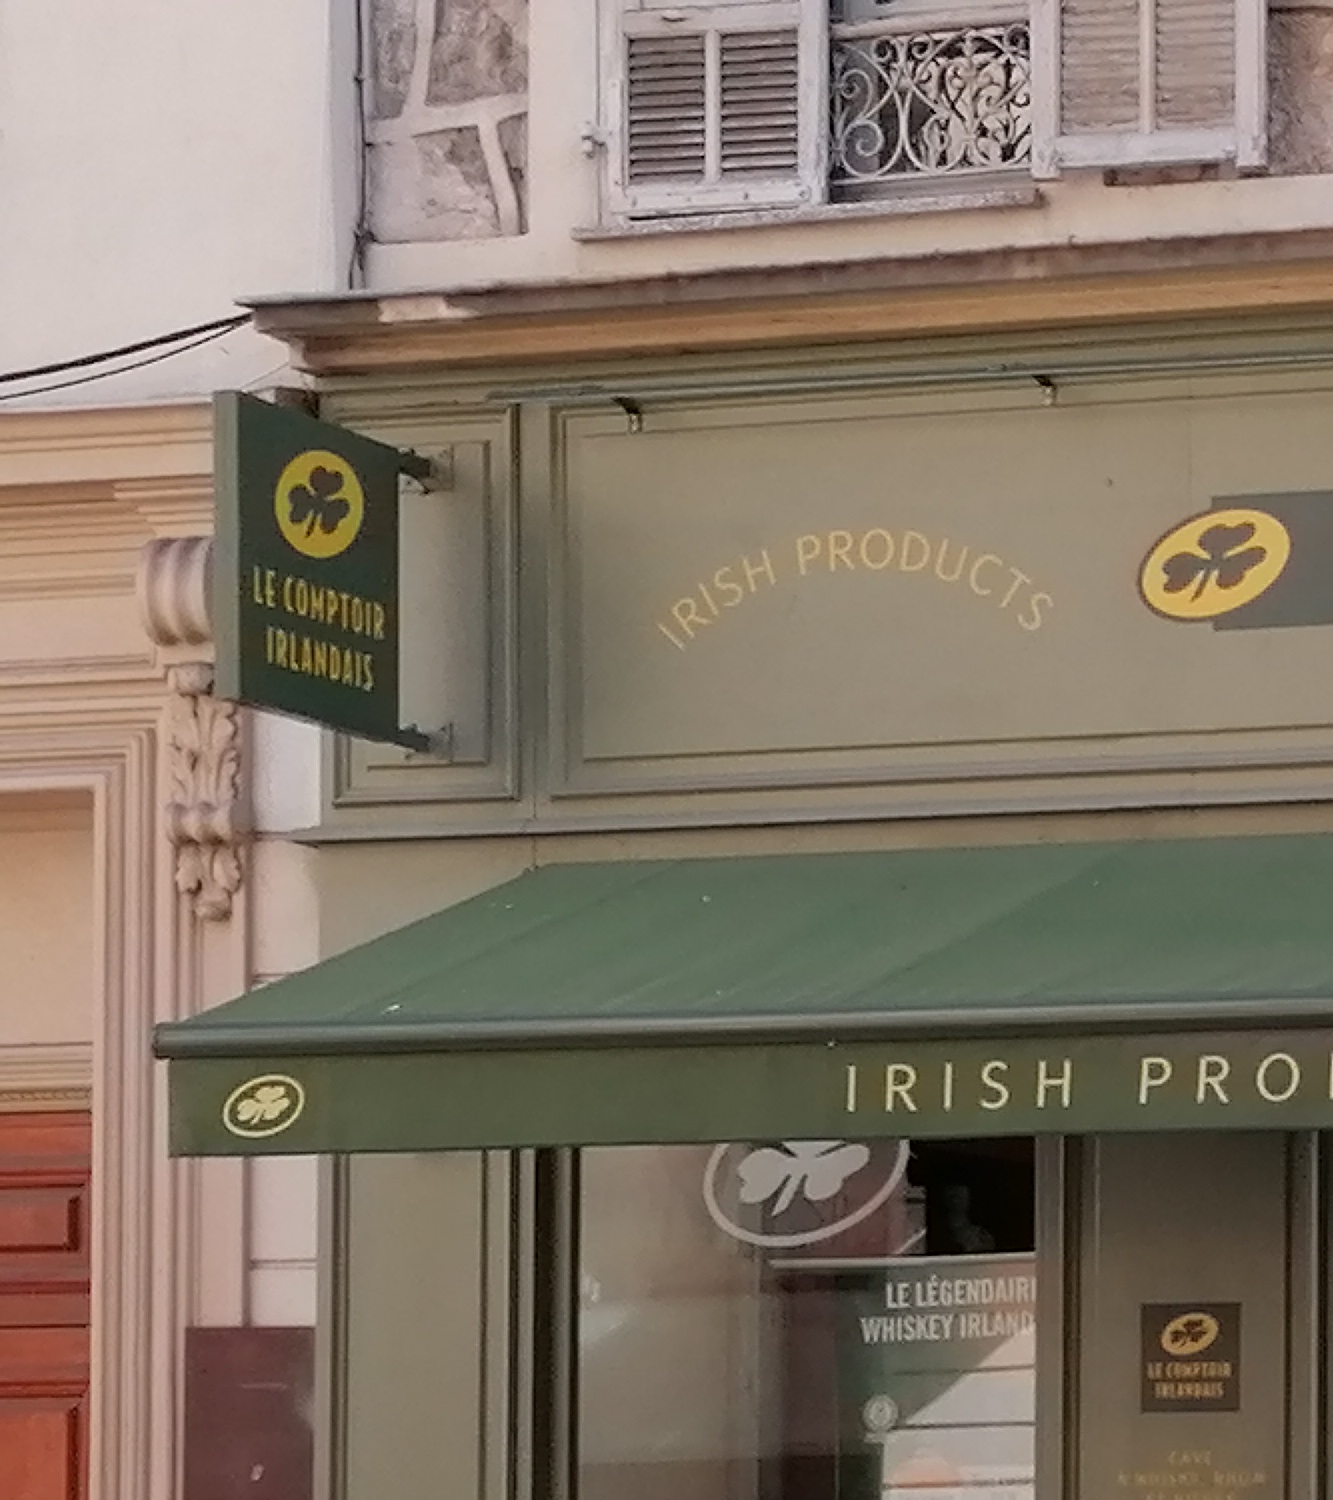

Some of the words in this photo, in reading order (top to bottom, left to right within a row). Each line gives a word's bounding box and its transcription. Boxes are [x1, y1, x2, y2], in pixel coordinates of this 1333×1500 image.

[253, 565, 277, 609] LE
[282, 574, 385, 641] COMPTOIR
[657, 547, 777, 652] IRISH
[796, 527, 1055, 632] PRODUCTS
[266, 625, 374, 692] IRLANDAIS
[845, 1059, 1073, 1114] IRISH
[885, 1281, 911, 1309] LE
[860, 1313, 954, 1346] WHISKEY
